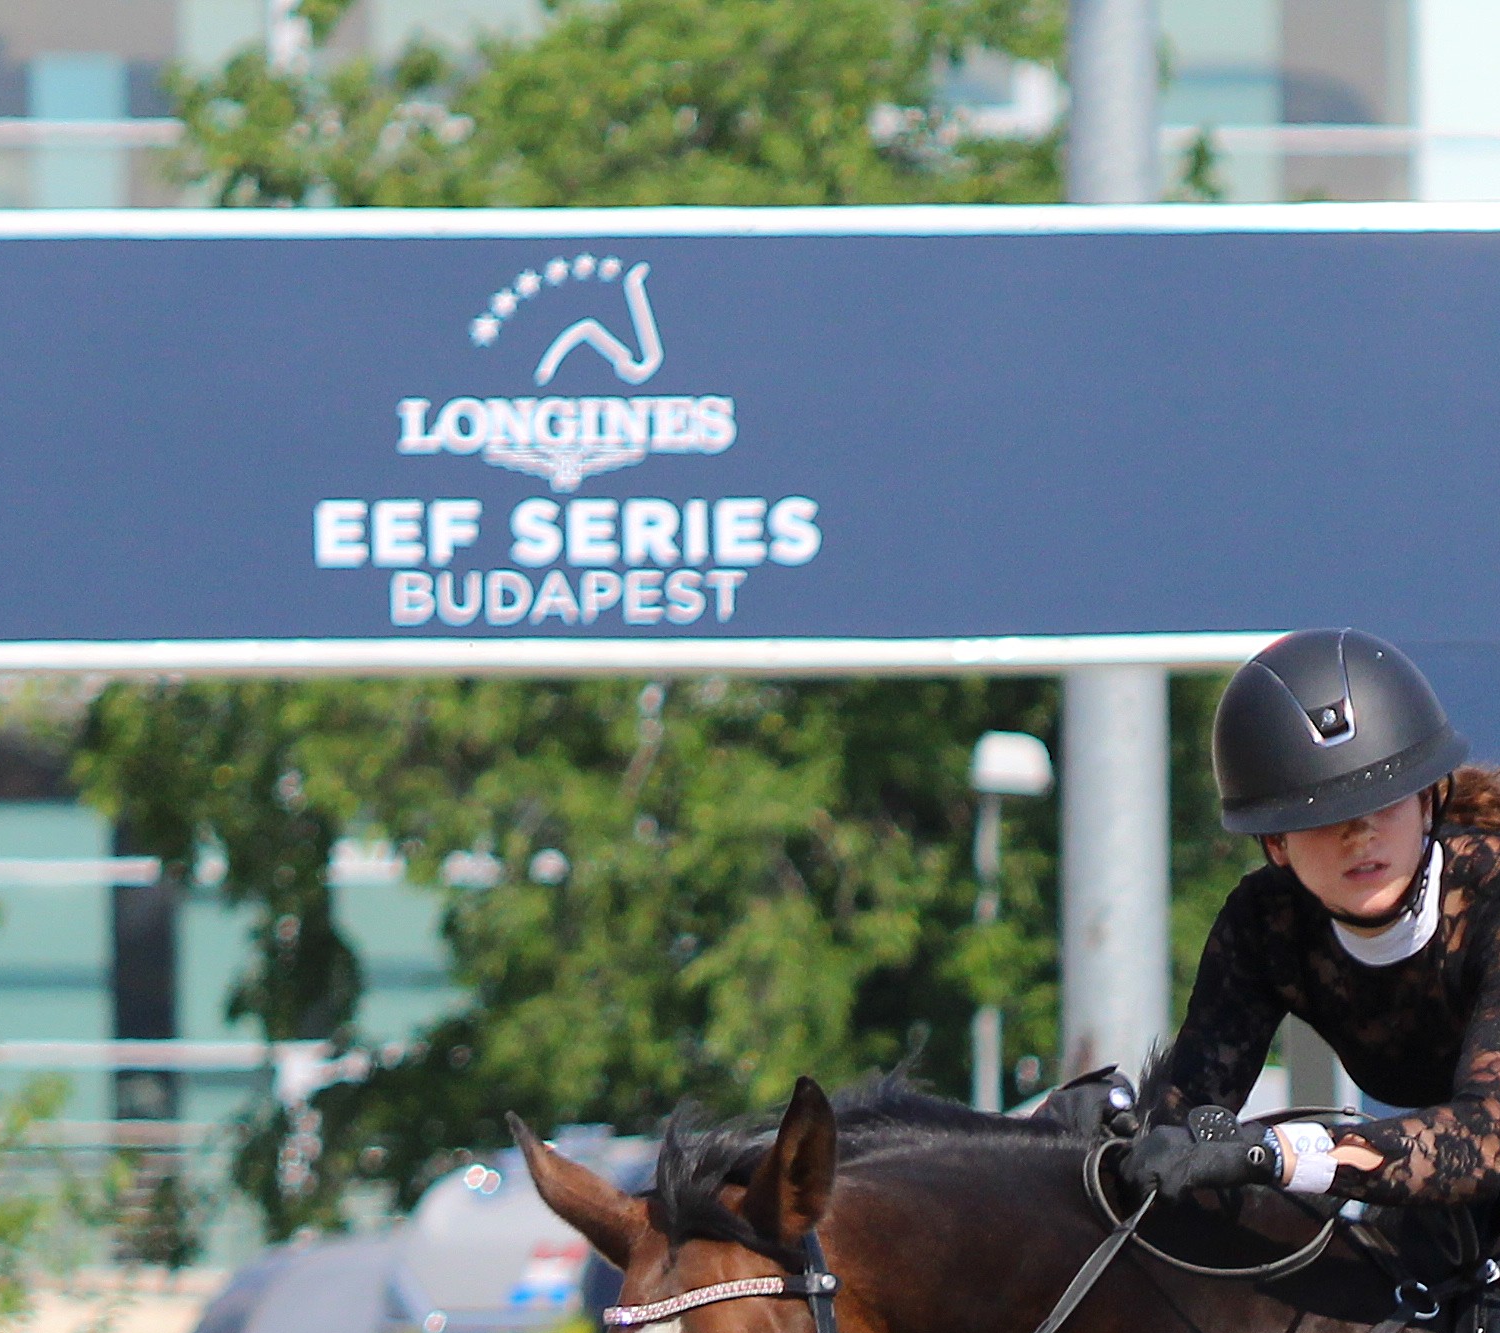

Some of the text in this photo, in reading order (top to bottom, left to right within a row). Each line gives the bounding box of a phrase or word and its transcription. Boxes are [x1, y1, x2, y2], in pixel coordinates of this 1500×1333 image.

[398, 396, 737, 454] LONGINES
[314, 496, 822, 567] EEF SERIES
[390, 569, 748, 626] BUDAPEST
